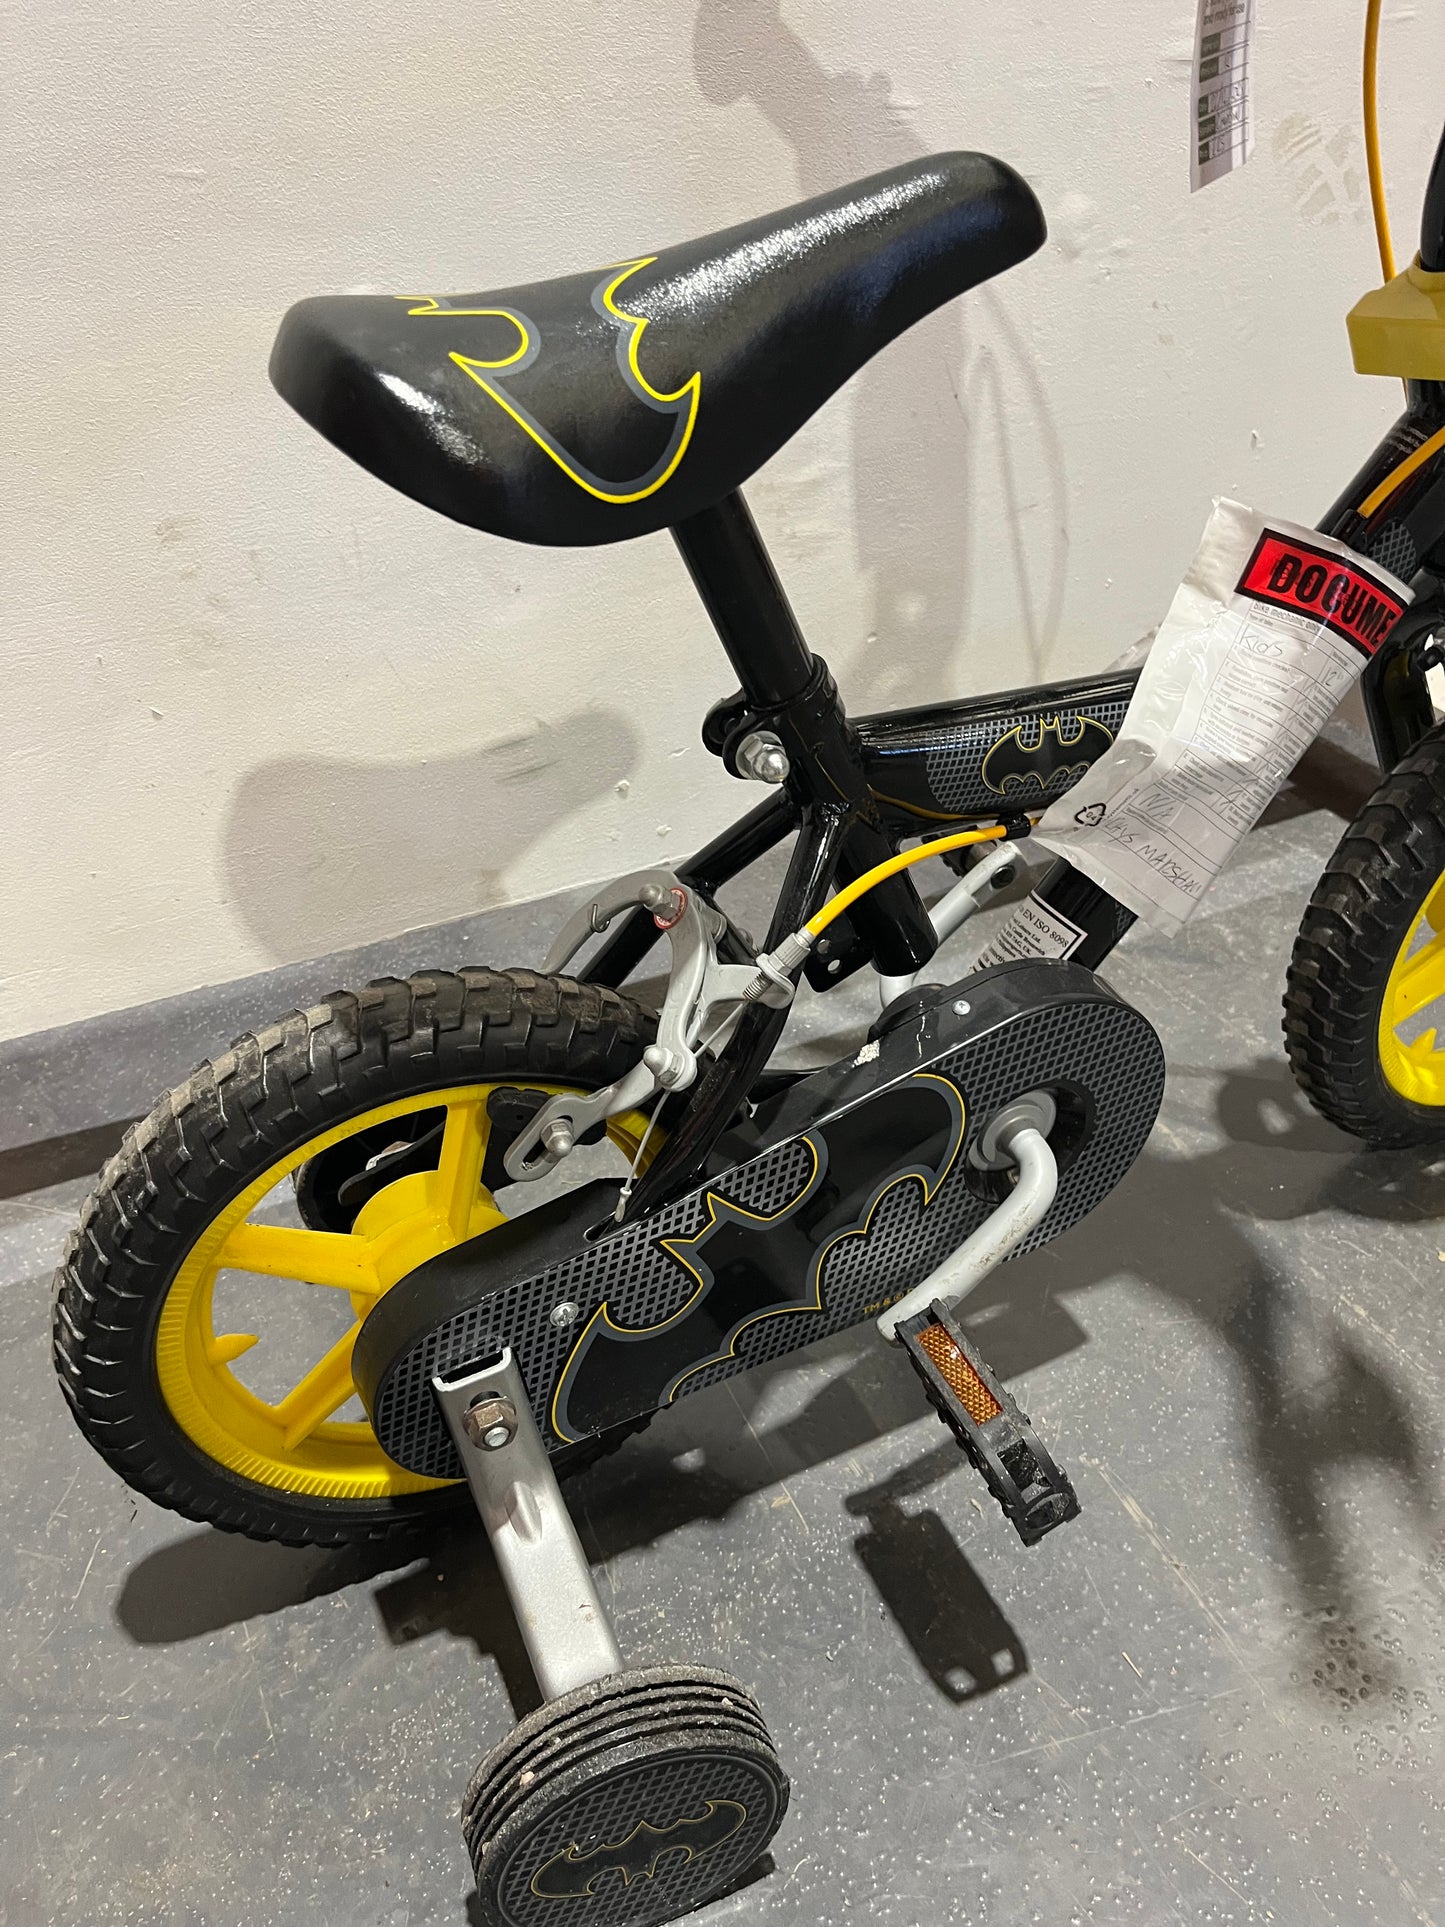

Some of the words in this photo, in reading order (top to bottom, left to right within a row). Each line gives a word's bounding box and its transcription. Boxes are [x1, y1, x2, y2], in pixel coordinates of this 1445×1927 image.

[1267, 553, 1397, 646] DOCUME
[1022, 908, 1036, 921] EN
[1033, 918, 1050, 934] ISO
[863, 1302, 880, 1314] TM
